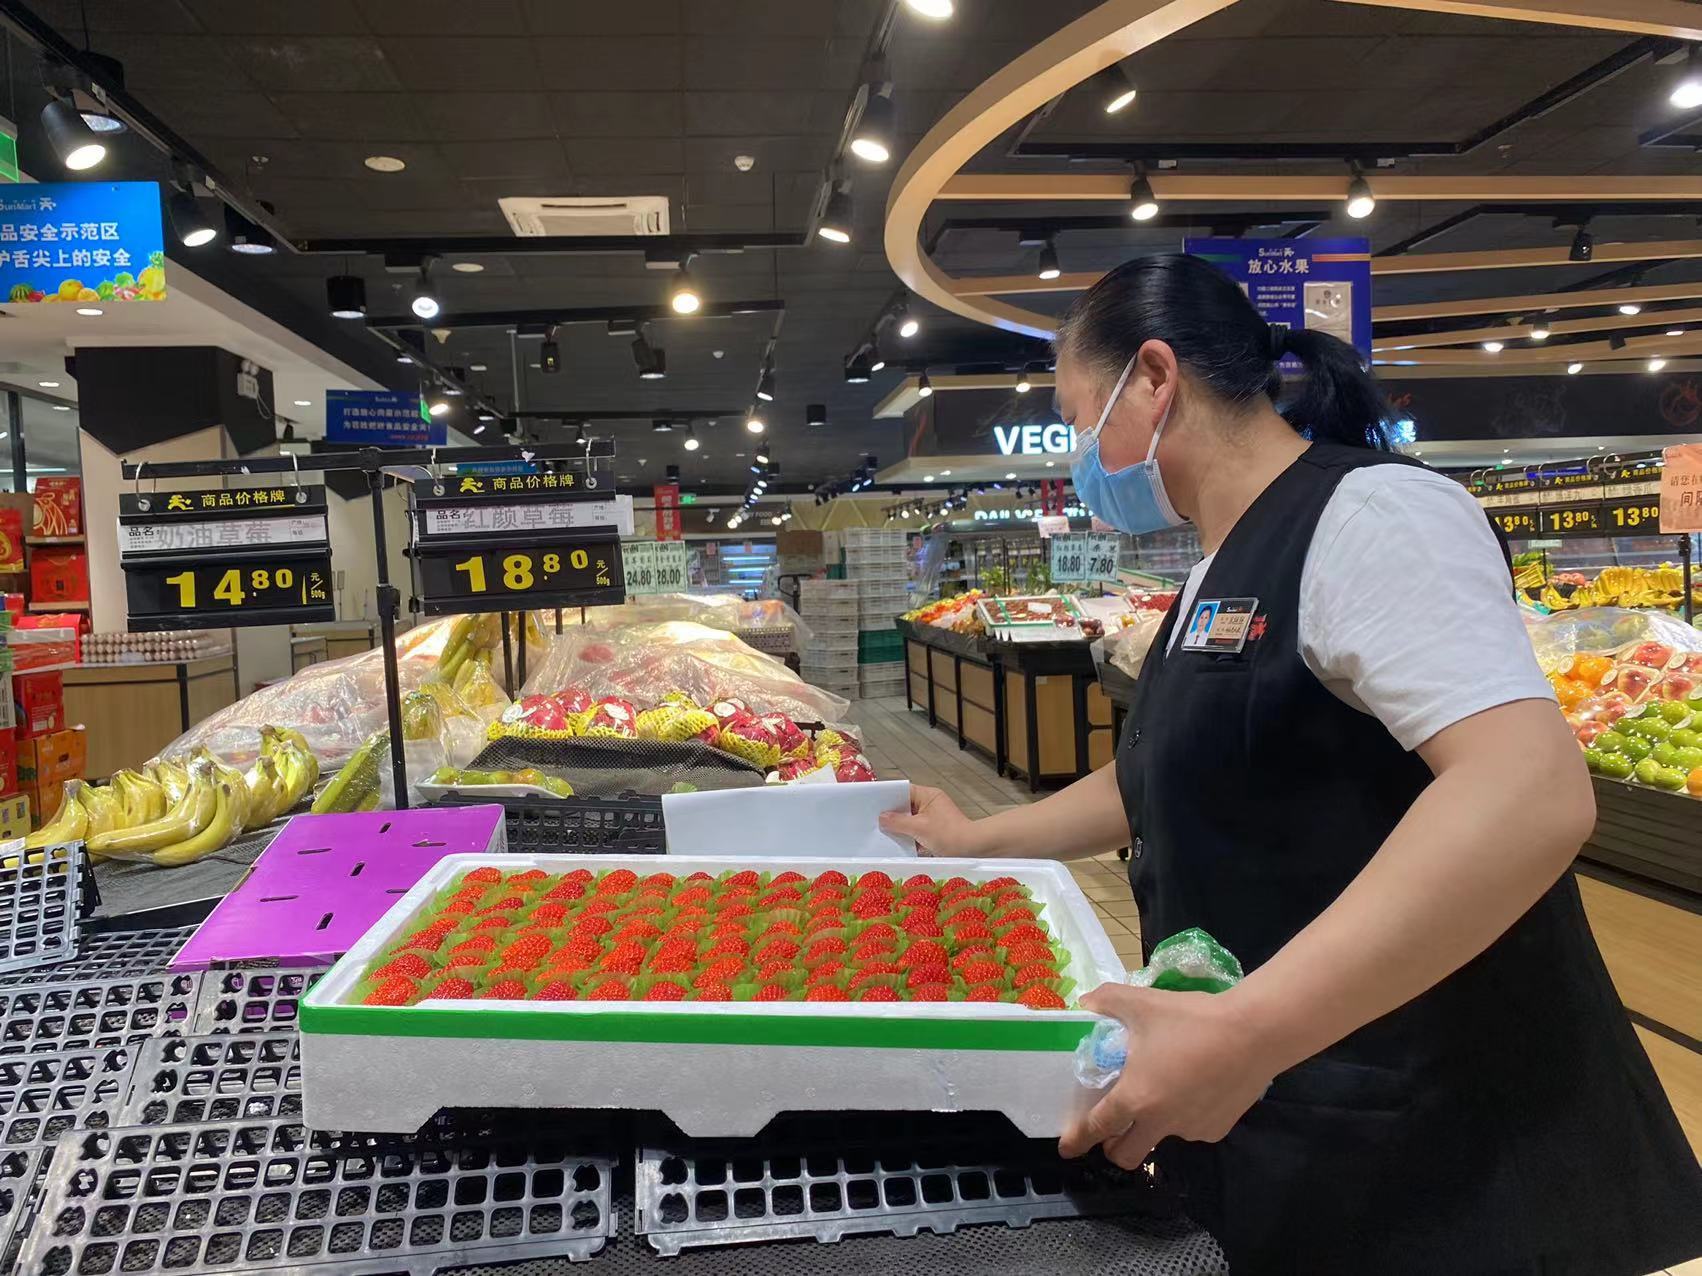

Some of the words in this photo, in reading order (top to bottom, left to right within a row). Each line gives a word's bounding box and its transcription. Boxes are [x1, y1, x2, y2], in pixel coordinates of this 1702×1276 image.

[1, 222, 120, 241] 品安全示范区
[1248, 259, 1309, 273] 放心水果
[493, 474, 575, 490] 商品价格牌
[201, 490, 286, 508] 商品价格牌
[1550, 511, 1589, 530] 13.80
[1612, 506, 1659, 526] 13.80
[1058, 555, 1081, 573] 18.80
[1090, 557, 1114, 575] 7.80
[627, 569, 652, 586] 24.80
